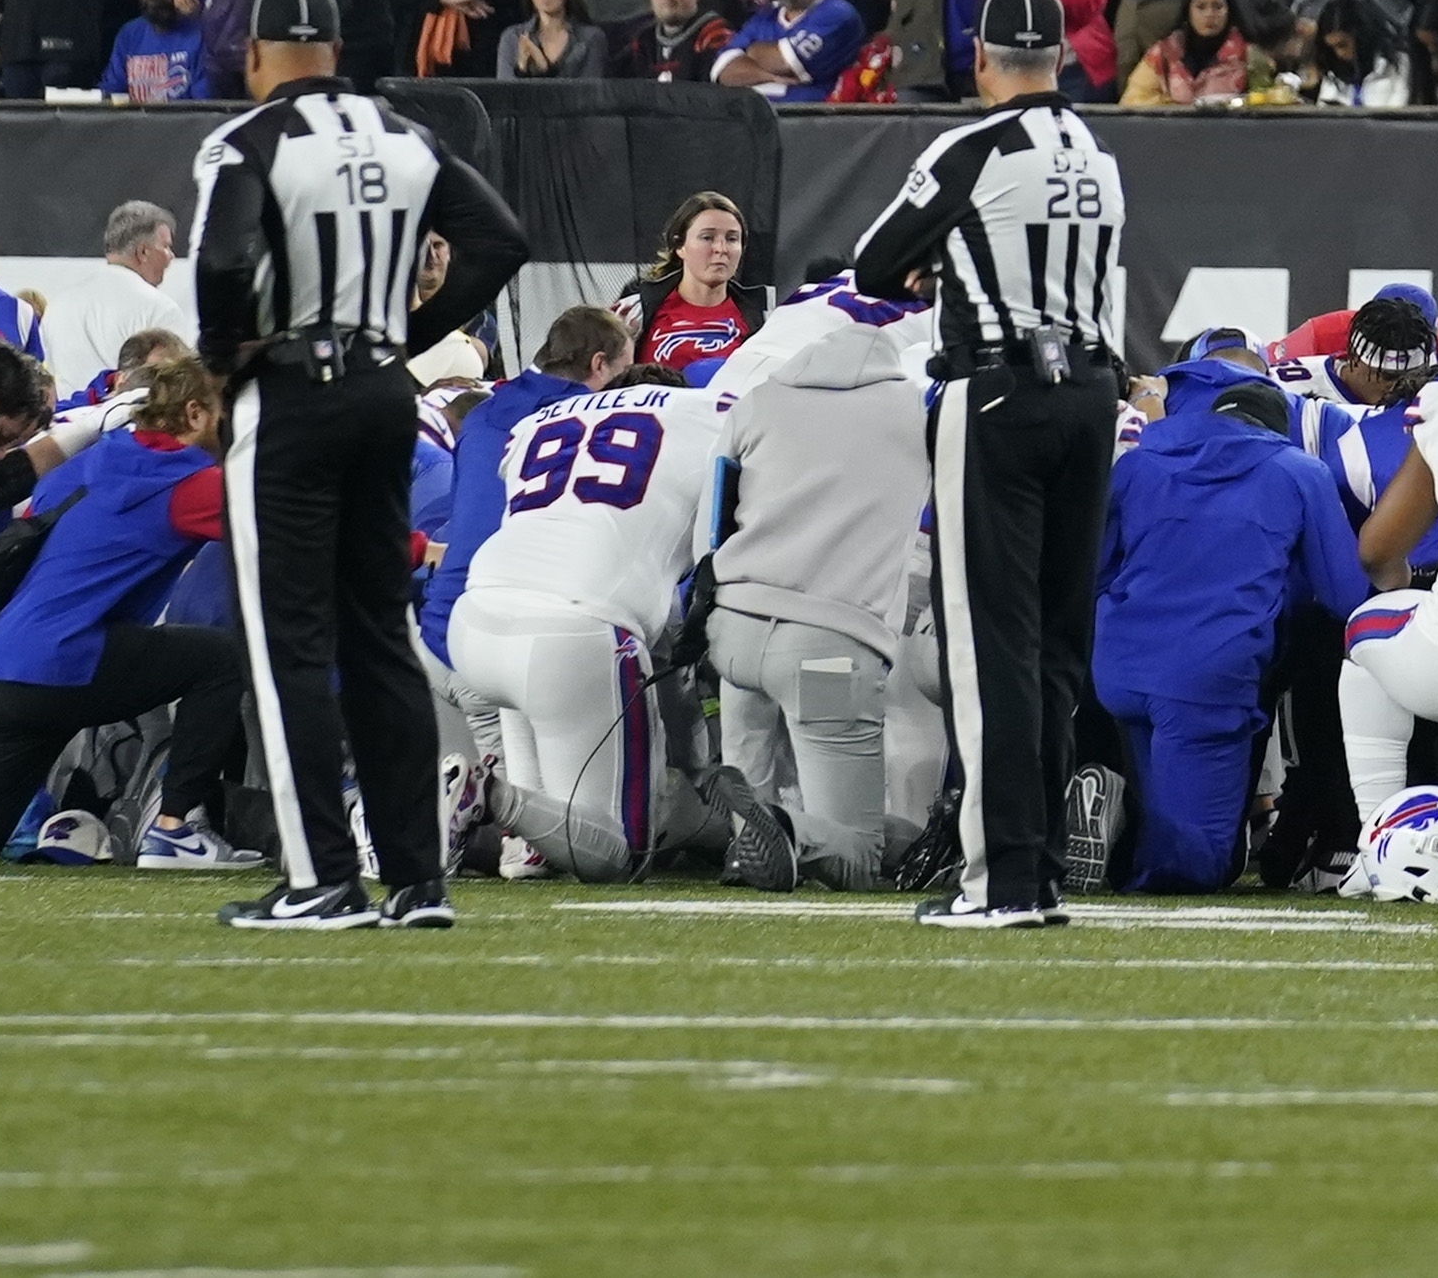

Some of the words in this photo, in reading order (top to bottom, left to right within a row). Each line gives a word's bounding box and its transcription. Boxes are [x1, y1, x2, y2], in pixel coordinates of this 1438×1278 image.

[335, 162, 388, 204] 18
[1046, 178, 1102, 219] 28
[533, 389, 627, 424] SETTLE
[632, 387, 671, 410] JR
[510, 412, 664, 515] 99
